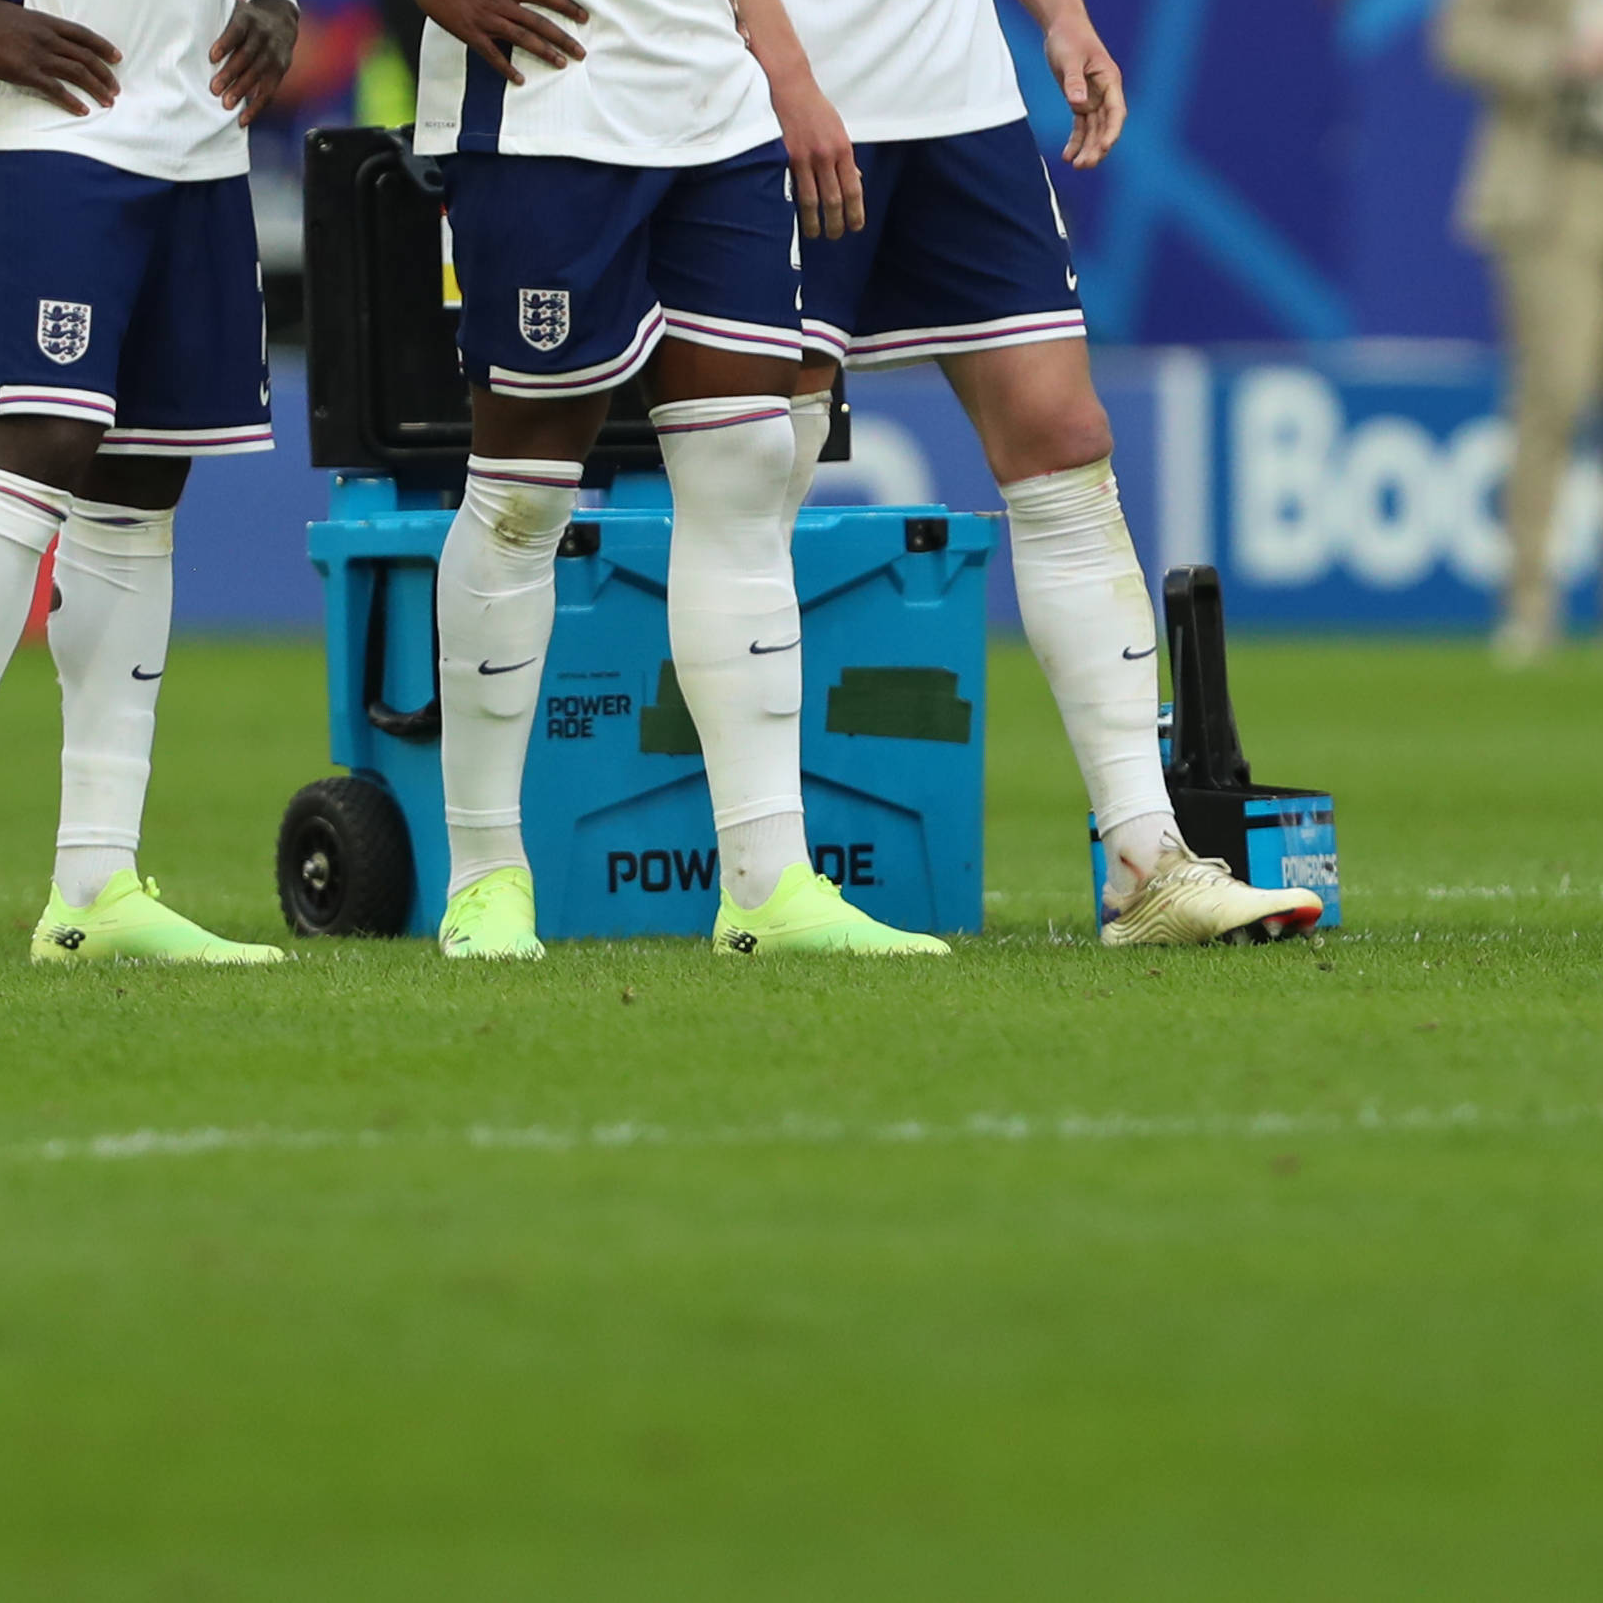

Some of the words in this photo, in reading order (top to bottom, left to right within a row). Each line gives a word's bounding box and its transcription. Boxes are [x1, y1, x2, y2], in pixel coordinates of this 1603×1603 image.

[547, 694, 632, 718] POWER
[547, 717, 595, 739] ADE
[608, 843, 875, 894] POWDE
